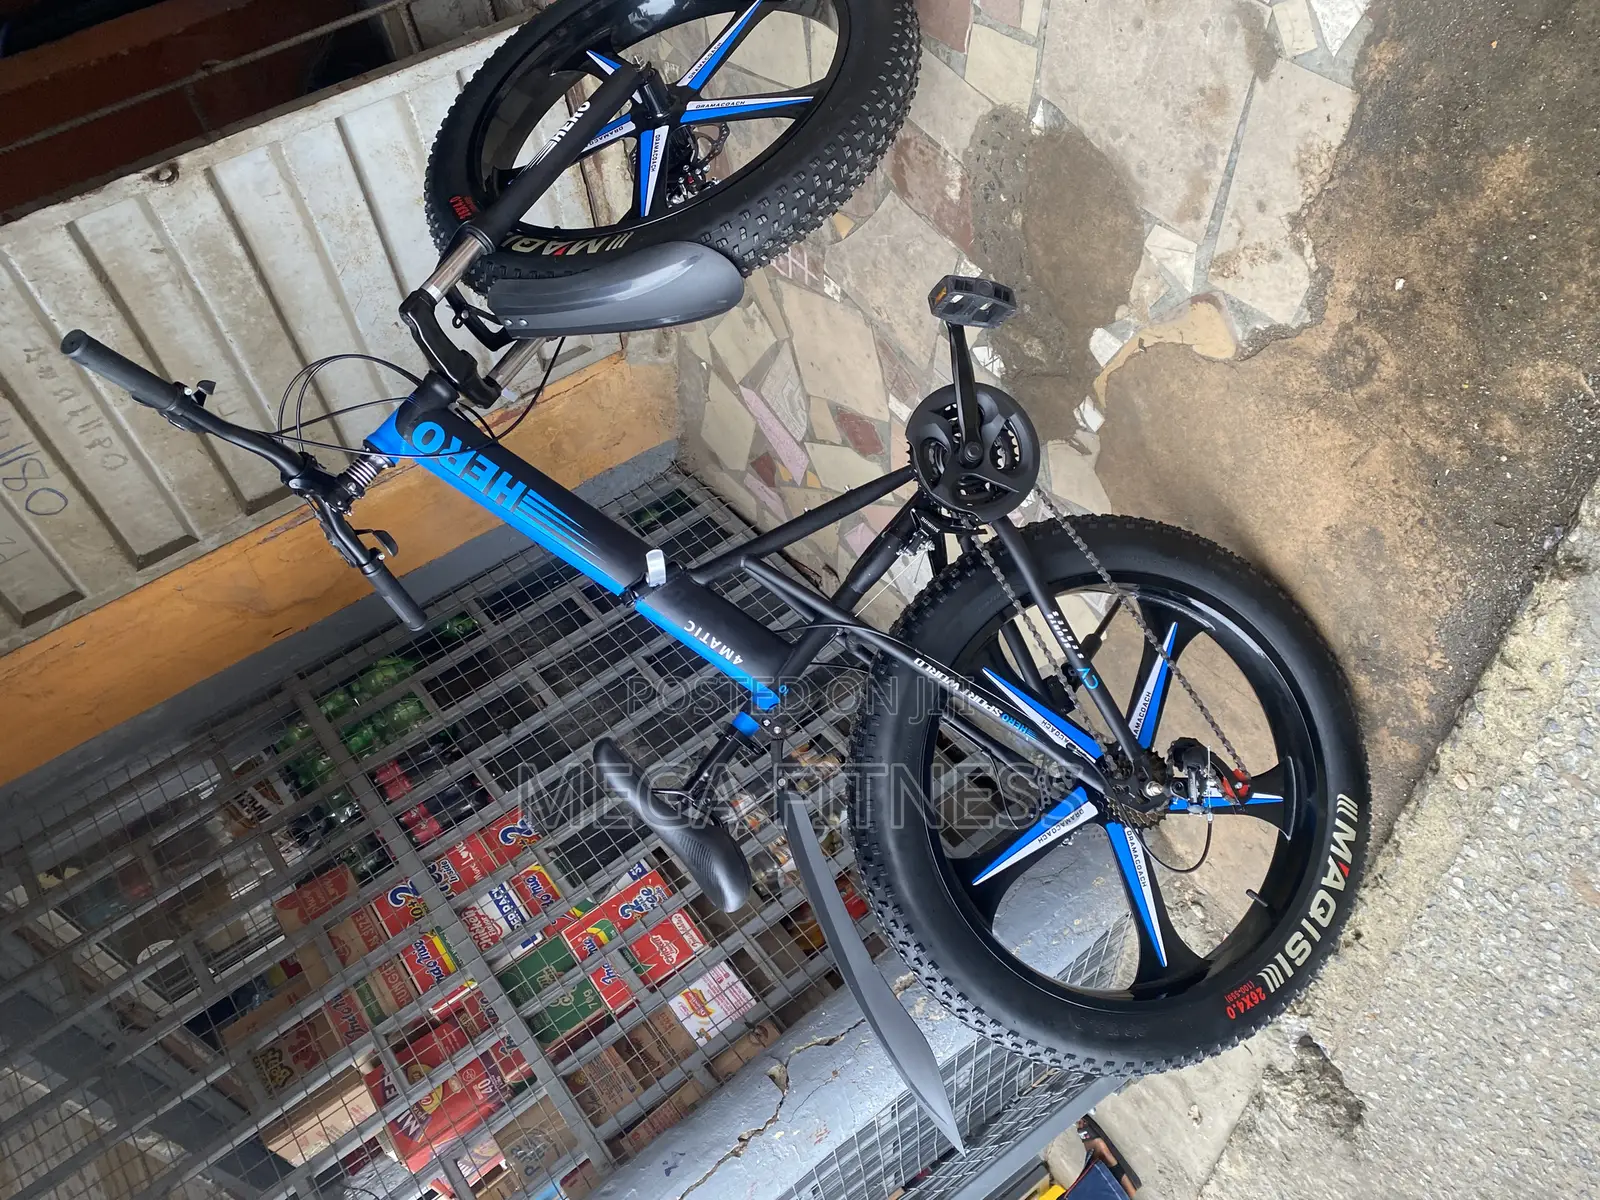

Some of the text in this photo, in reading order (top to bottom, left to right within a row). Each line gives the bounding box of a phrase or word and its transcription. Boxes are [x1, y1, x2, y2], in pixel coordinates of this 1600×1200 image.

[411, 421, 531, 513] HERO
[683, 619, 745, 667] 4MATIC
[1077, 666, 1100, 691] CV
[912, 657, 1029, 735] HERO SPORT WORLD
[1133, 691, 1152, 739] AMACOACH
[1038, 809, 1085, 844] DRAMACOACH
[1127, 830, 1147, 888] DRAMACOACH
[384, 877, 419, 909] 2
[615, 895, 644, 921] 2
[639, 884, 663, 909] ree
[407, 938, 446, 985] ndomie
[583, 987, 598, 1008] 70g
[1226, 986, 1266, 1020] 26X4.0
[475, 1076, 495, 1096] 40
